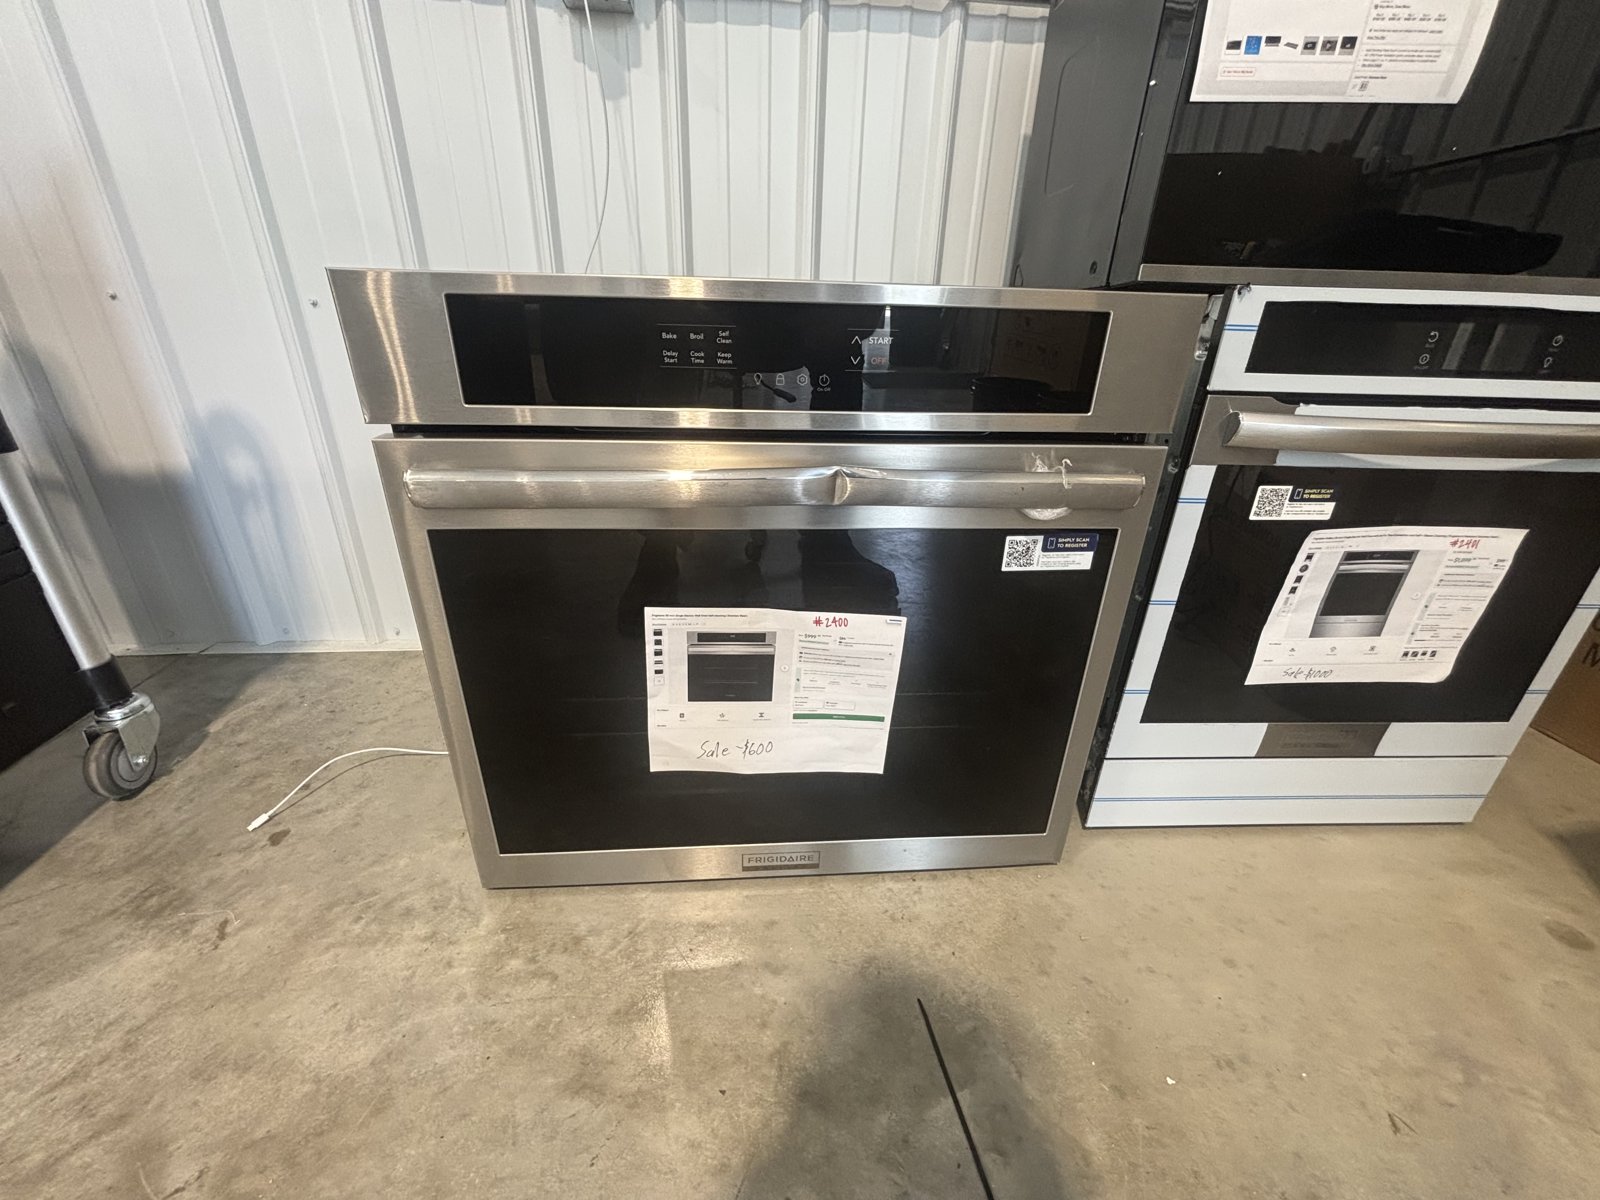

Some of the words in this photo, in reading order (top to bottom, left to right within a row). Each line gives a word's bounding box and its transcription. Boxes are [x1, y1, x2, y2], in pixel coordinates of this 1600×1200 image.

[689, 332, 704, 340] Broil
[868, 336, 894, 345] START
[870, 357, 889, 365] OFF
[812, 616, 849, 628] #2400
[697, 740, 731, 759] Sale
[747, 854, 814, 864] FRIGIDAIRE
